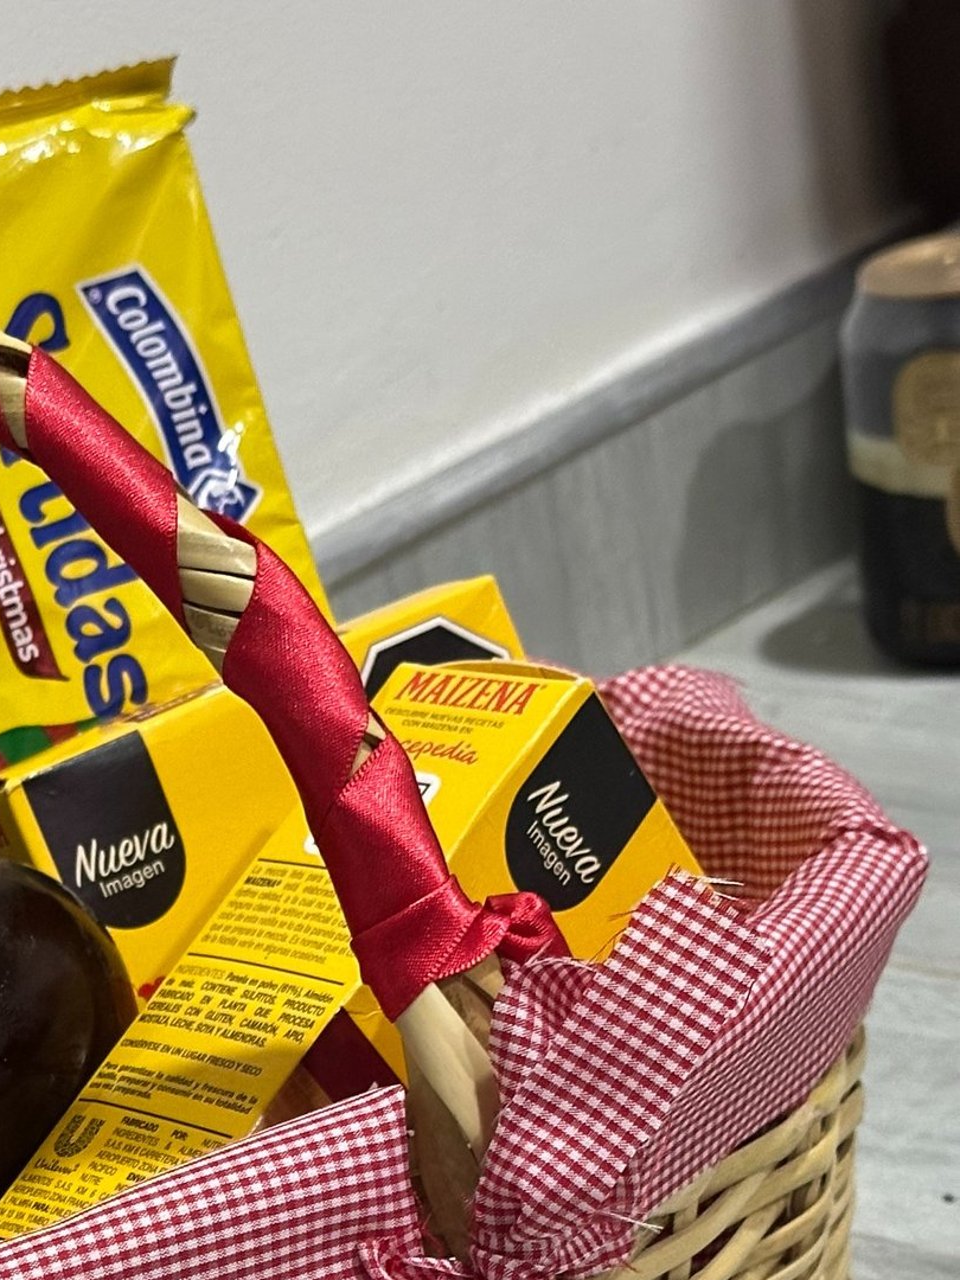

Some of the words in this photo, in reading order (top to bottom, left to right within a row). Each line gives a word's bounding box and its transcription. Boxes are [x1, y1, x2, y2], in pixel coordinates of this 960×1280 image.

[105, 284, 212, 470] Colombina
[400, 740, 479, 765] cepedia
[527, 780, 601, 884] Nueva
[75, 822, 175, 889] Nueva
[525, 820, 572, 886] Imagen
[99, 860, 165, 899] Imagen
[184, 1007, 203, 1016] CON
[200, 982, 237, 996] CONTIENE
[283, 999, 325, 1016] PRODUCTO
[218, 999, 247, 1011] PLANTA
[254, 1007, 272, 1018] QUE
[278, 1013, 315, 1029] PROCESA
[181, 1049, 207, 1062] LUGAR
[205, 1055, 235, 1069] FRESCO
[240, 1064, 262, 1076] SECO
[201, 1083, 235, 1098] frescura
[215, 1098, 252, 1114] totalidad
[121, 1116, 159, 1132] FABRICADO
